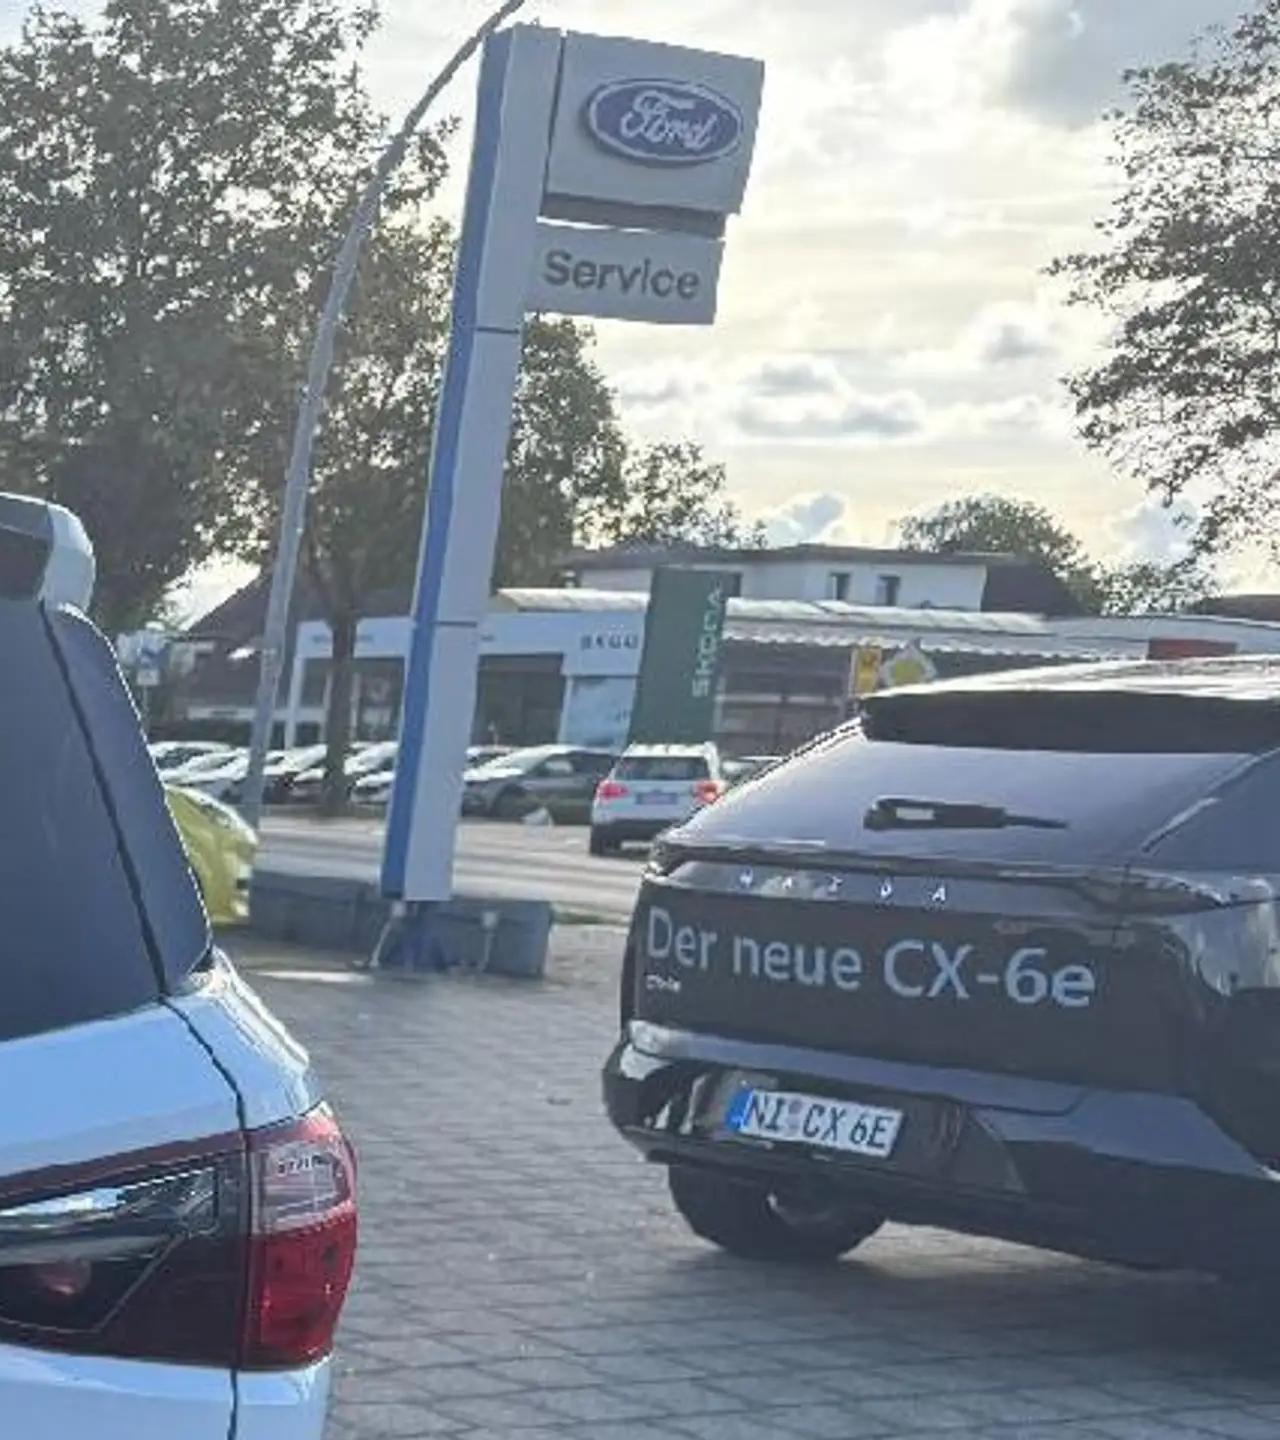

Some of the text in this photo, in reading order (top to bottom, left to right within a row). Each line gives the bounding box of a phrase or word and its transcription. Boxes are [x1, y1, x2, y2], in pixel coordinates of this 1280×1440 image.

[619, 90, 719, 151] Ford
[543, 250, 701, 299] Service
[739, 868, 947, 902] MAZDA
[647, 907, 1096, 1007] Der neue CX-6e
[743, 1094, 894, 1149] NI CX 6E
